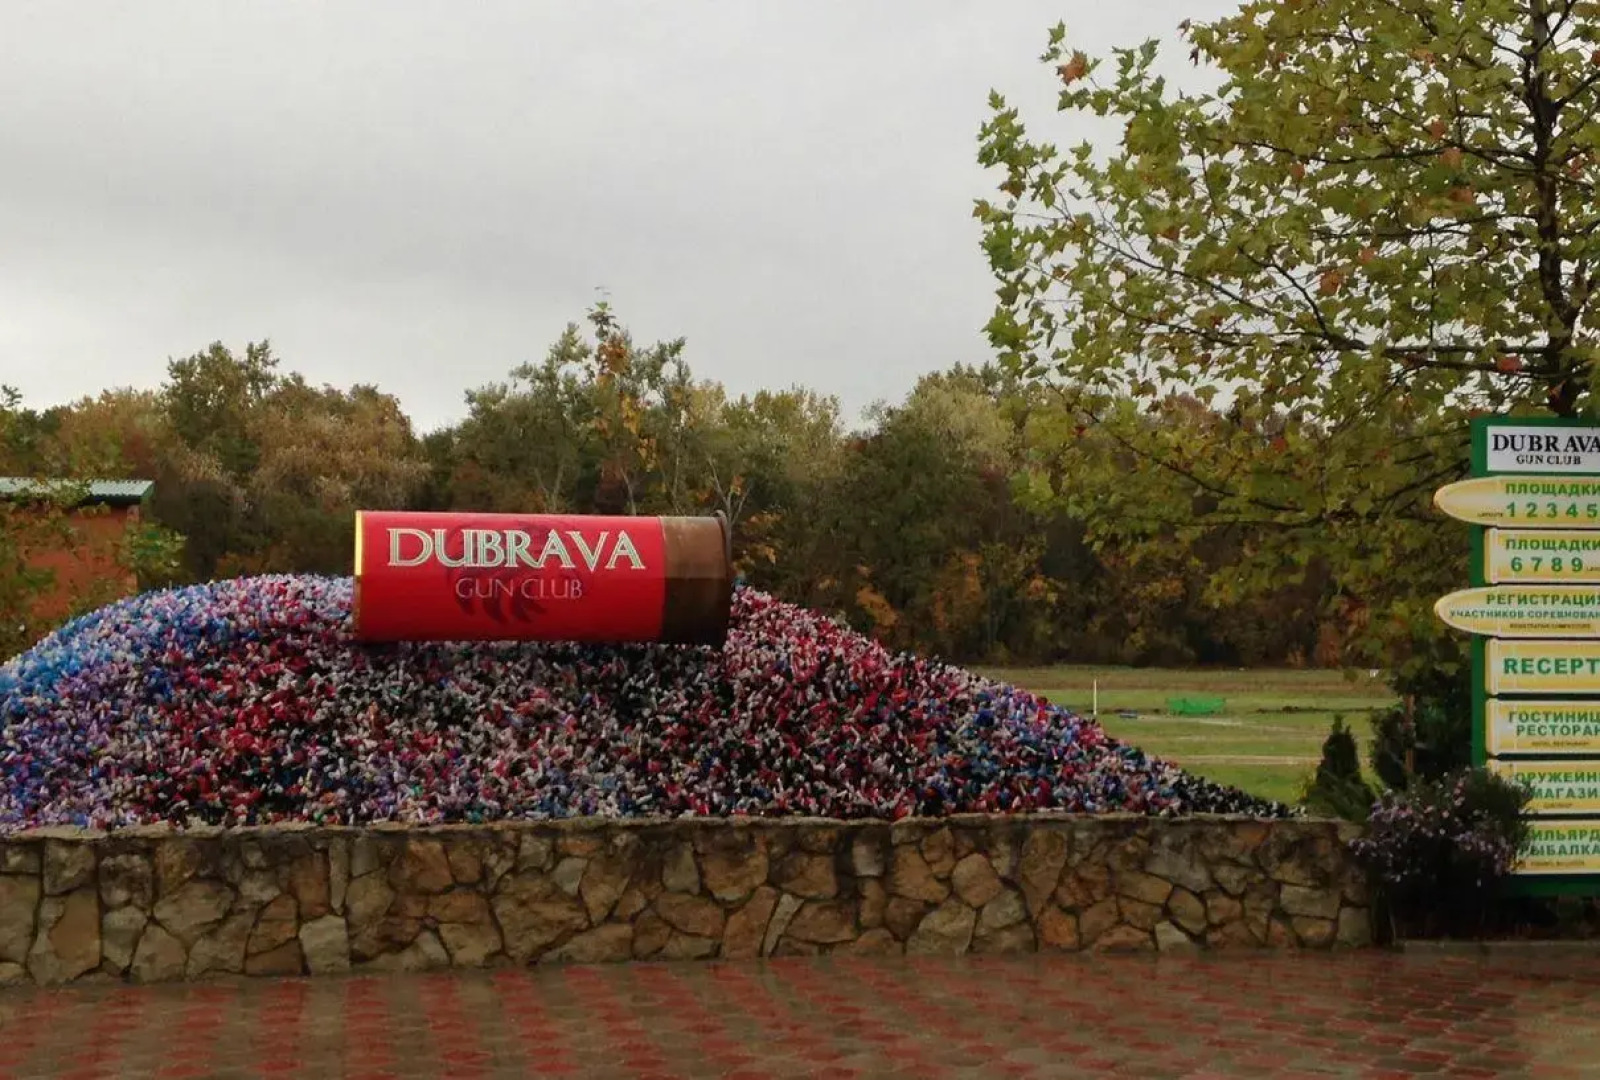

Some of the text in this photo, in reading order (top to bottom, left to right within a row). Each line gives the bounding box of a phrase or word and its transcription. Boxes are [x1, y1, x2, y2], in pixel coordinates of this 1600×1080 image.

[1516, 455, 1581, 465] GUN CLUB
[1506, 501, 1598, 518] 1 2 3 4 5
[387, 528, 646, 572] DUBRAVA
[1511, 557, 1583, 572] 6 7 8 9
[455, 577, 583, 600] GUN CLUB
[1486, 594, 1600, 607] РЕГИСТРАЦИ
[1450, 610, 1525, 619] УЧАСТНИКОВ
